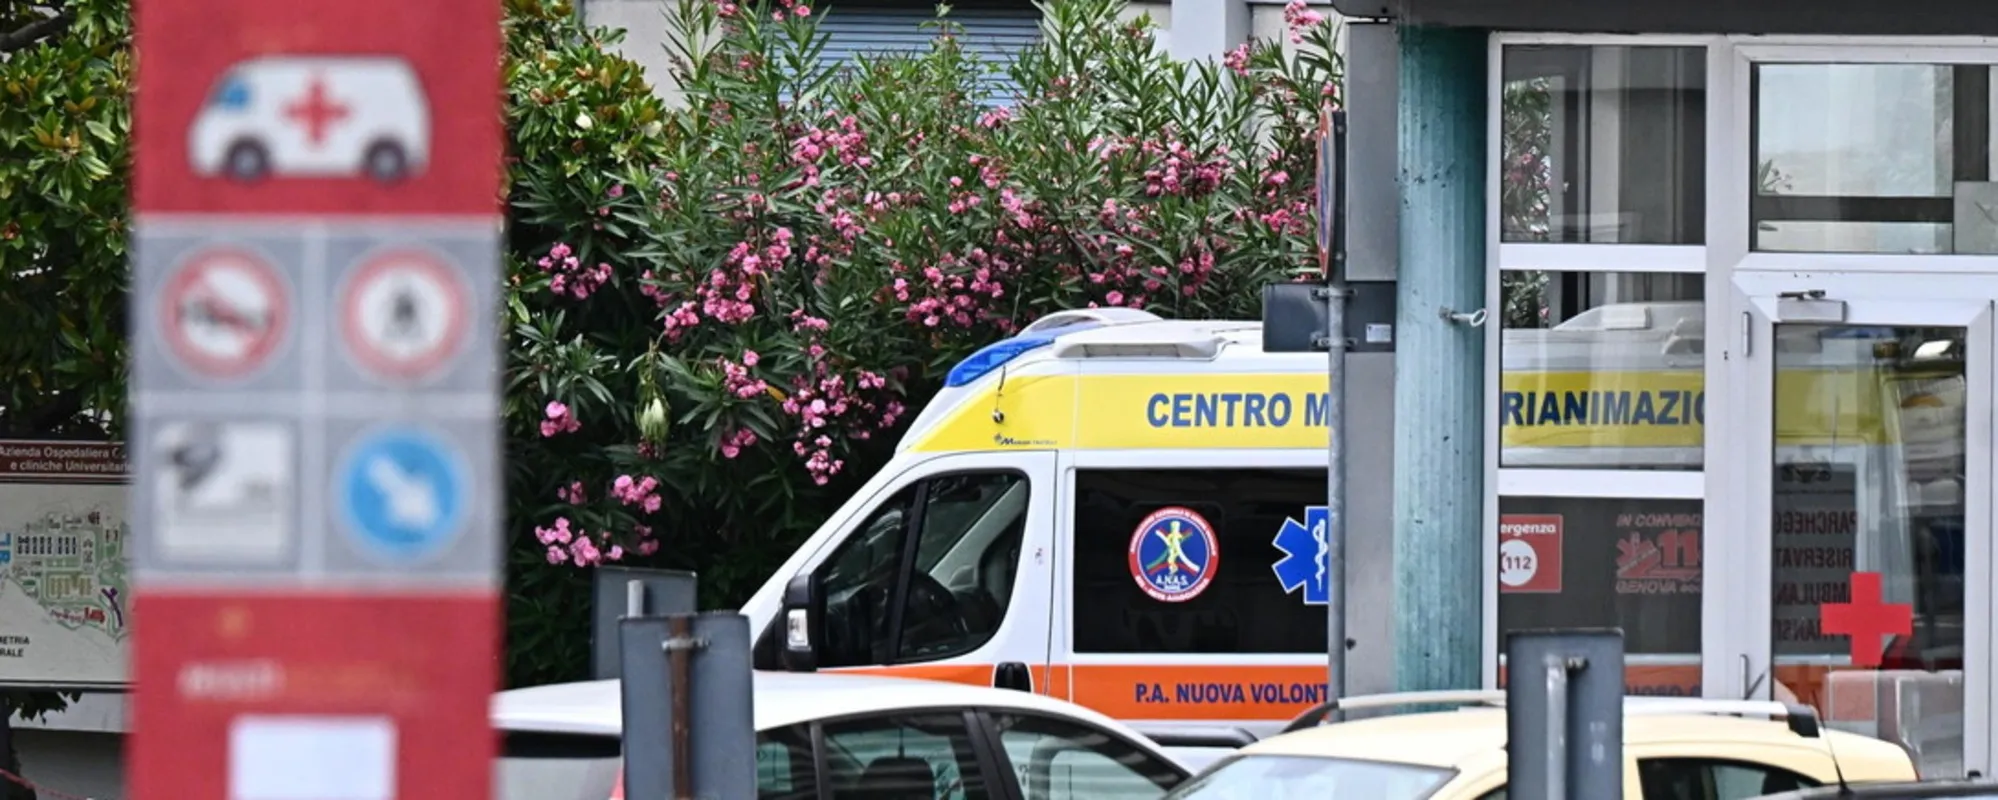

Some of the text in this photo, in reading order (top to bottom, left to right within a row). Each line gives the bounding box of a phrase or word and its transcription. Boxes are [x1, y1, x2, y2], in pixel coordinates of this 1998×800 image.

[1147, 393, 1292, 427] CENTRO
[44, 446, 109, 459] Ospedaliera
[20, 460, 62, 470] cliniche
[1506, 556, 1531, 570] 112
[1136, 684, 1169, 703] P.A.
[1176, 684, 1245, 703] NUOVA
